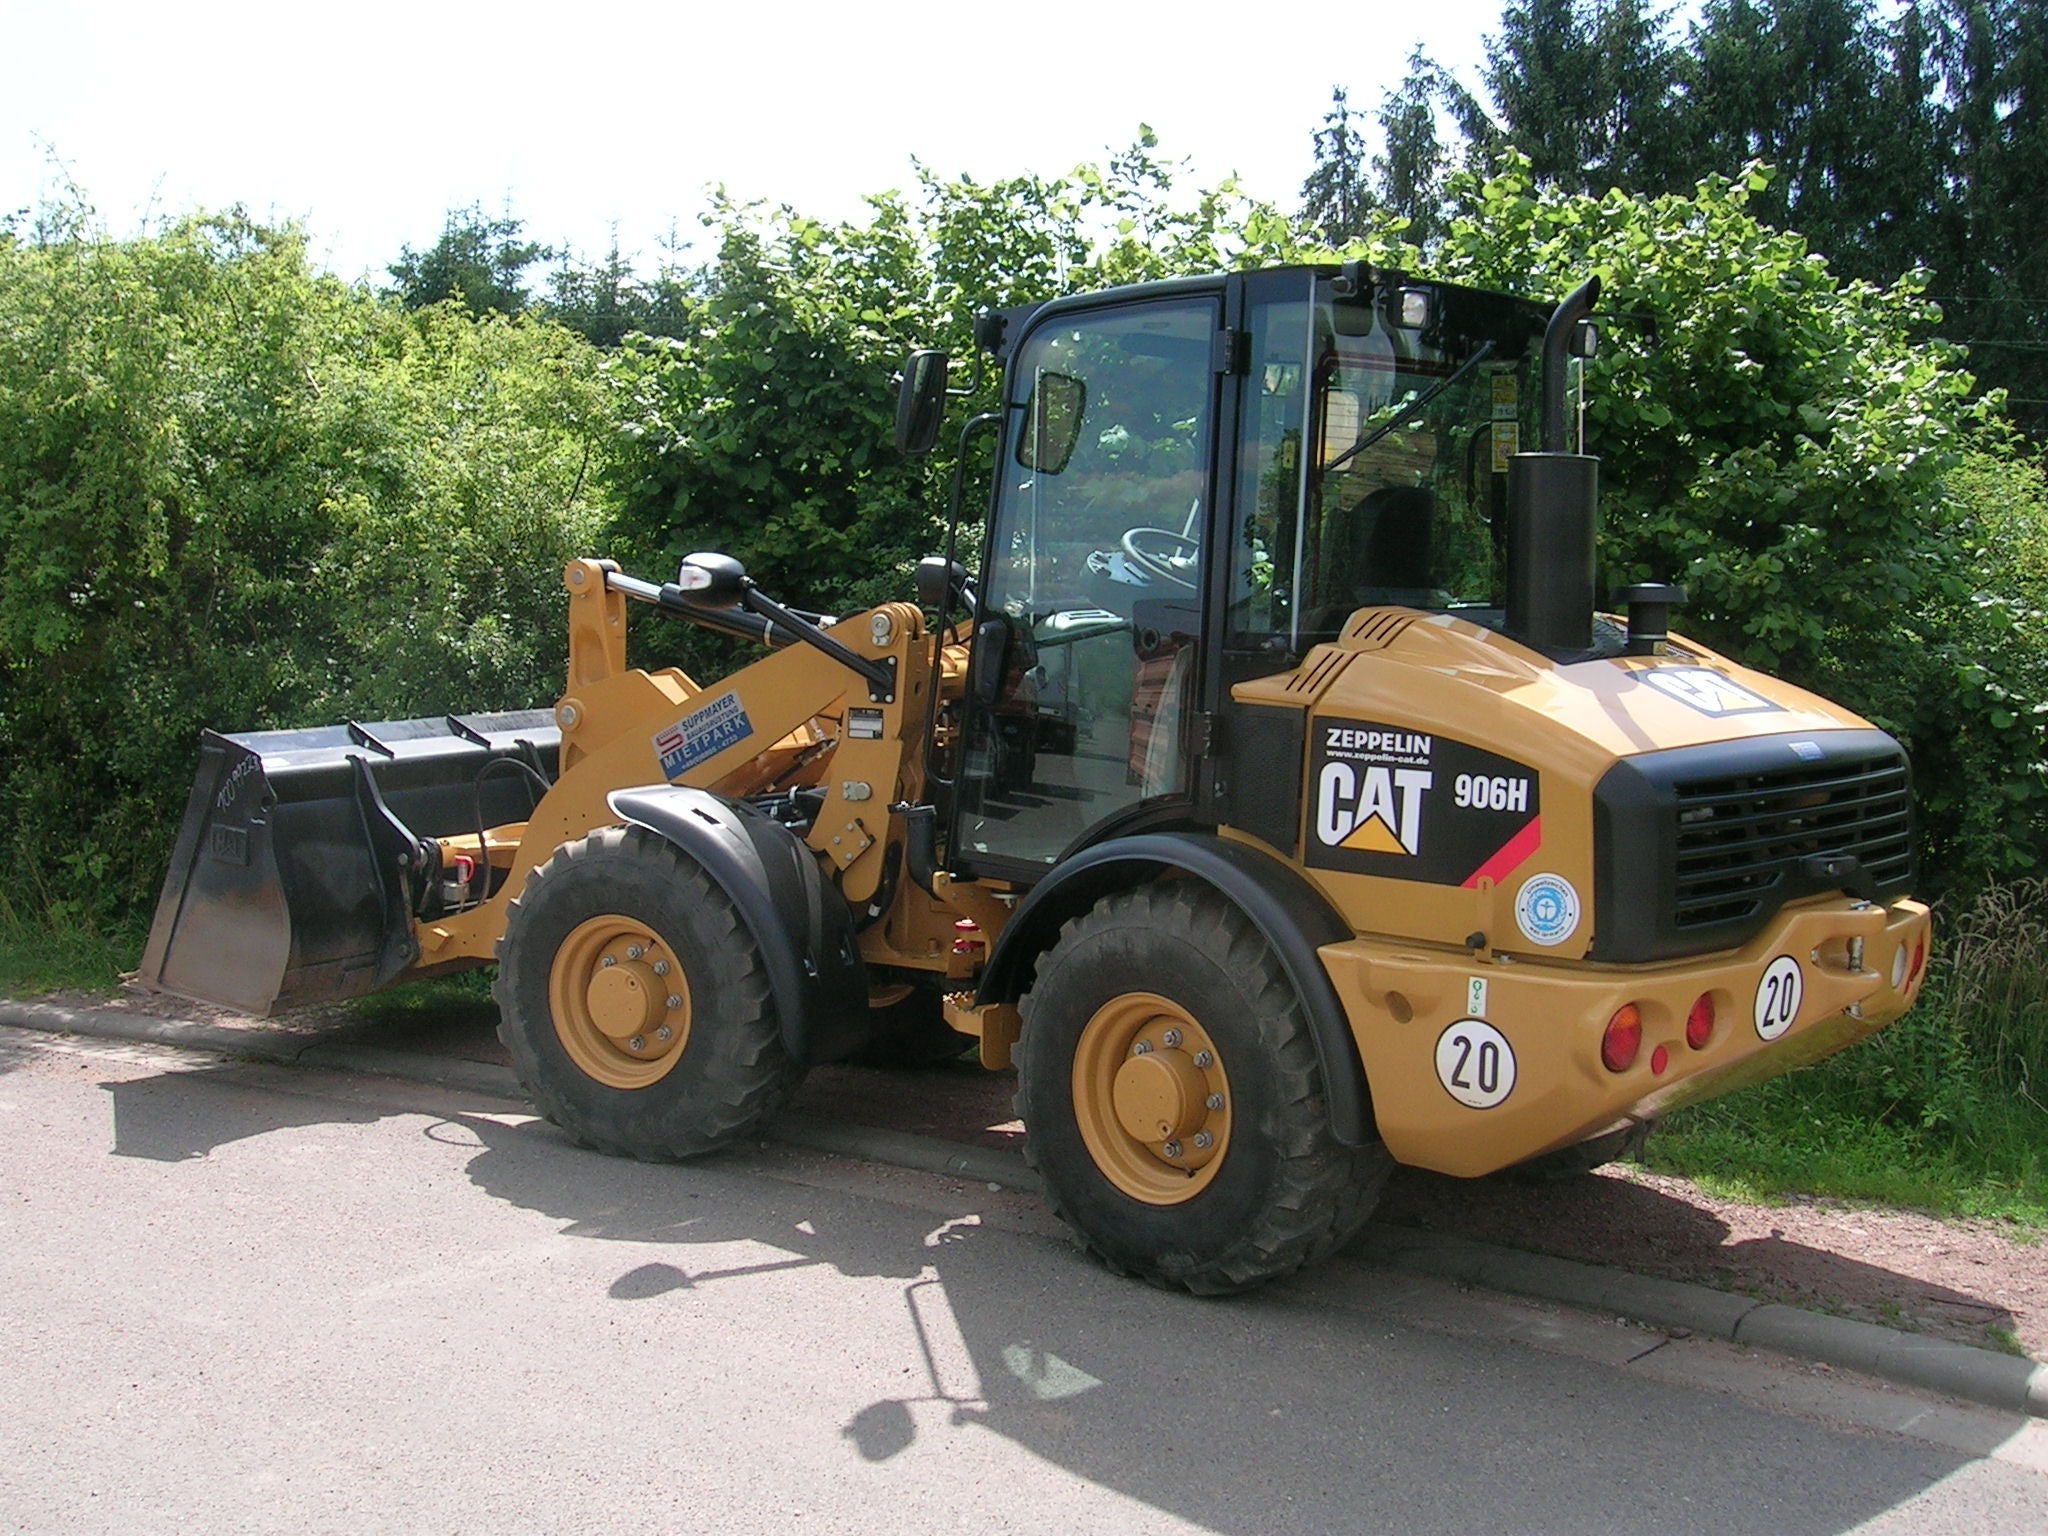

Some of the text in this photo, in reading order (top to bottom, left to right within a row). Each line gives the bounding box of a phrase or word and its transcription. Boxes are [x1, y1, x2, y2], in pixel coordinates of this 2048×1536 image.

[662, 714, 746, 770] MIETPARK
[1325, 749, 1431, 766] www.zeppelin-cat.de
[1326, 727, 1432, 755] ZEPPELIN
[1316, 761, 1433, 856] CAT
[1454, 773, 1529, 812] 906H
[1762, 971, 1795, 1028] 20
[1451, 1035, 1499, 1094] 20
